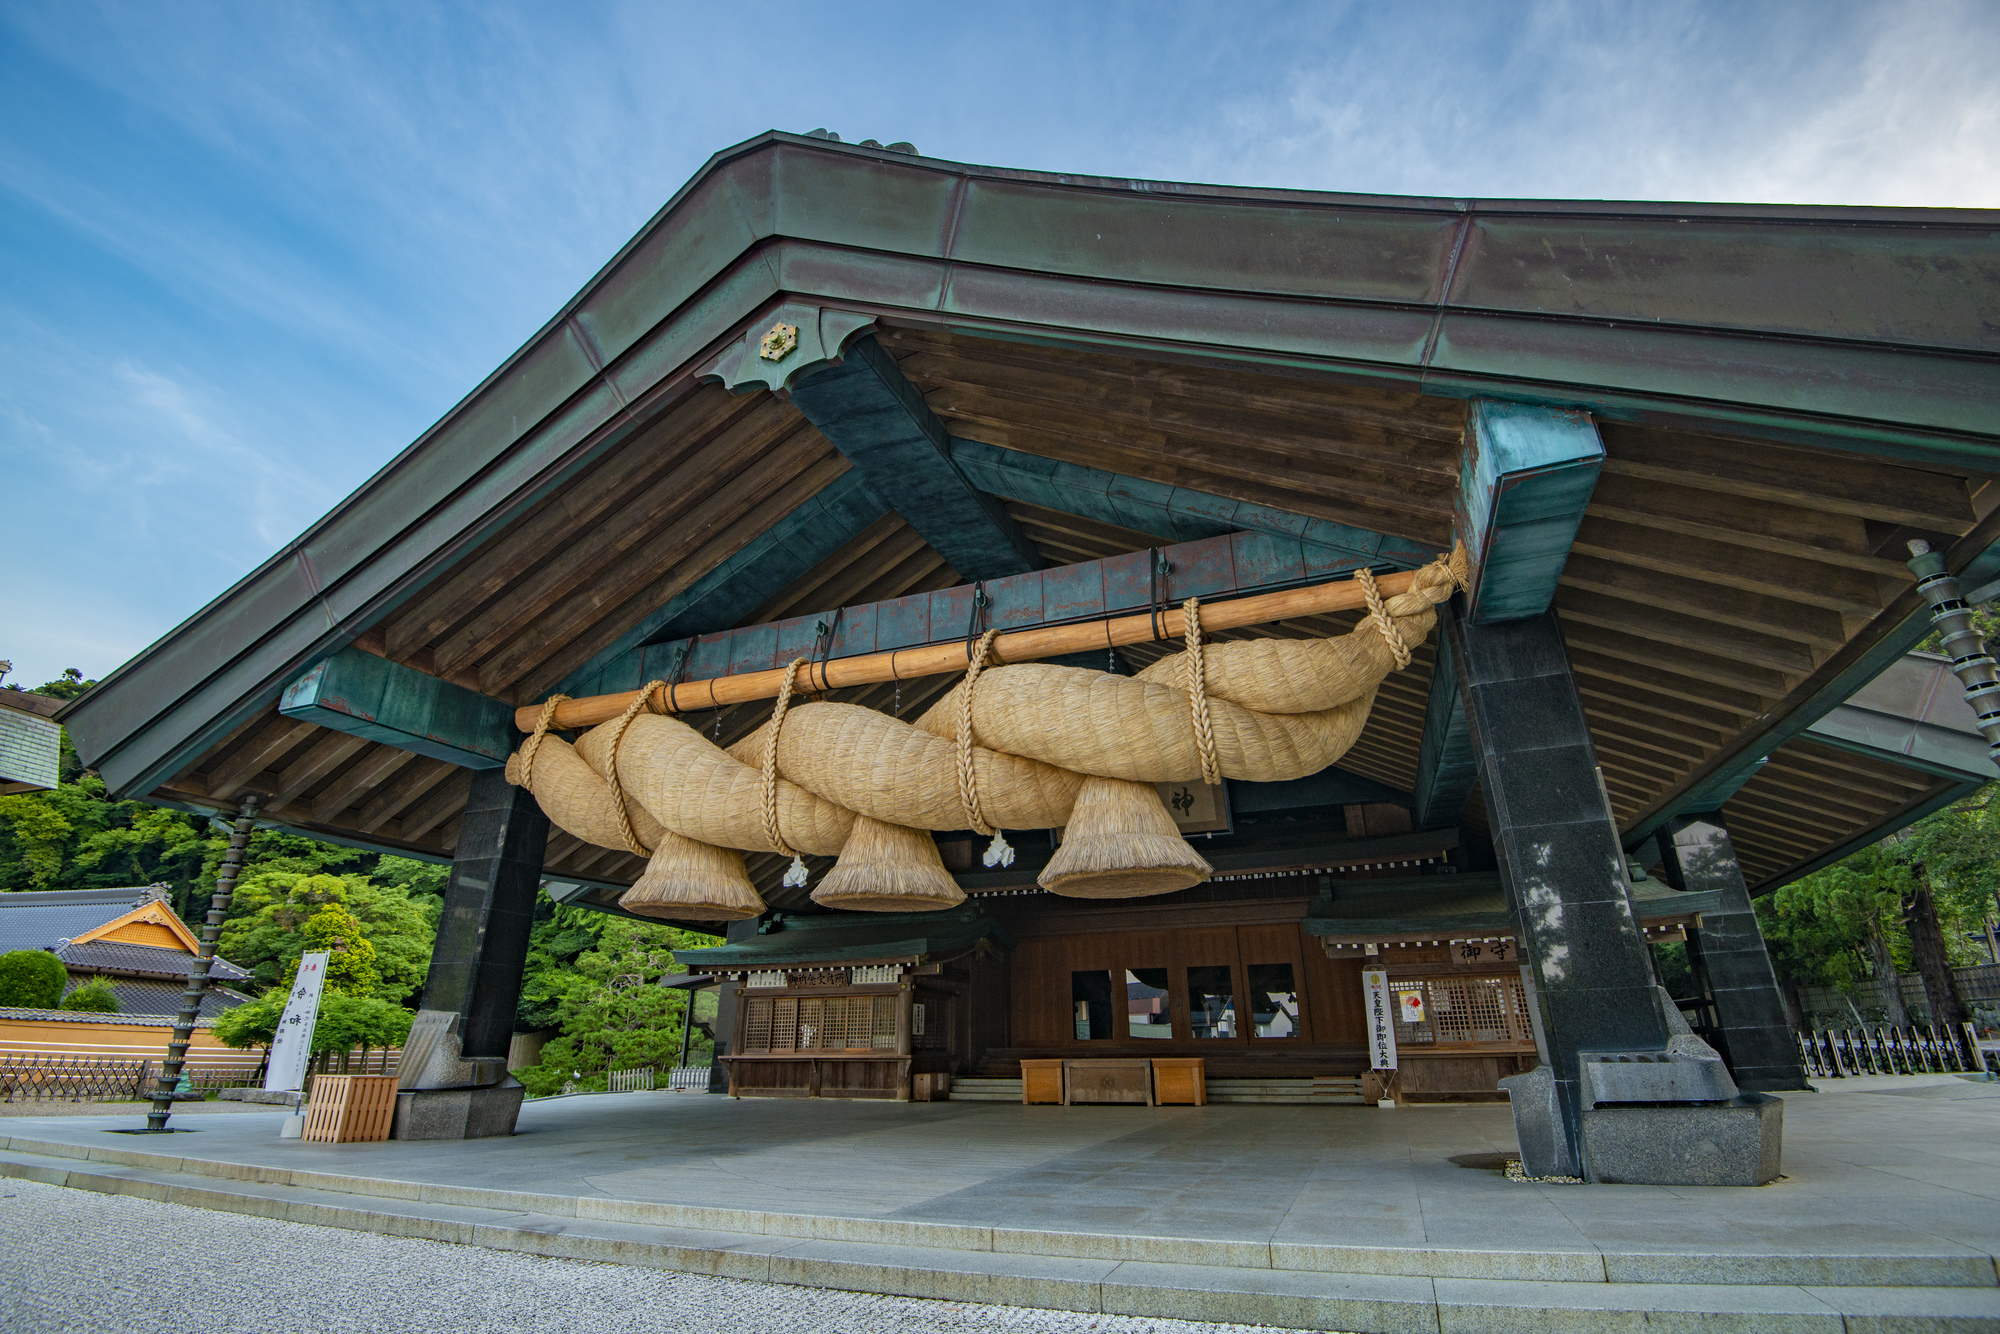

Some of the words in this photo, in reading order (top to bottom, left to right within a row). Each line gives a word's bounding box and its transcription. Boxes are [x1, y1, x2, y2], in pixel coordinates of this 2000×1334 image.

[1460, 942, 1510, 961] 御守
[1373, 991, 1389, 1067] 天皇陛下御即位大典
